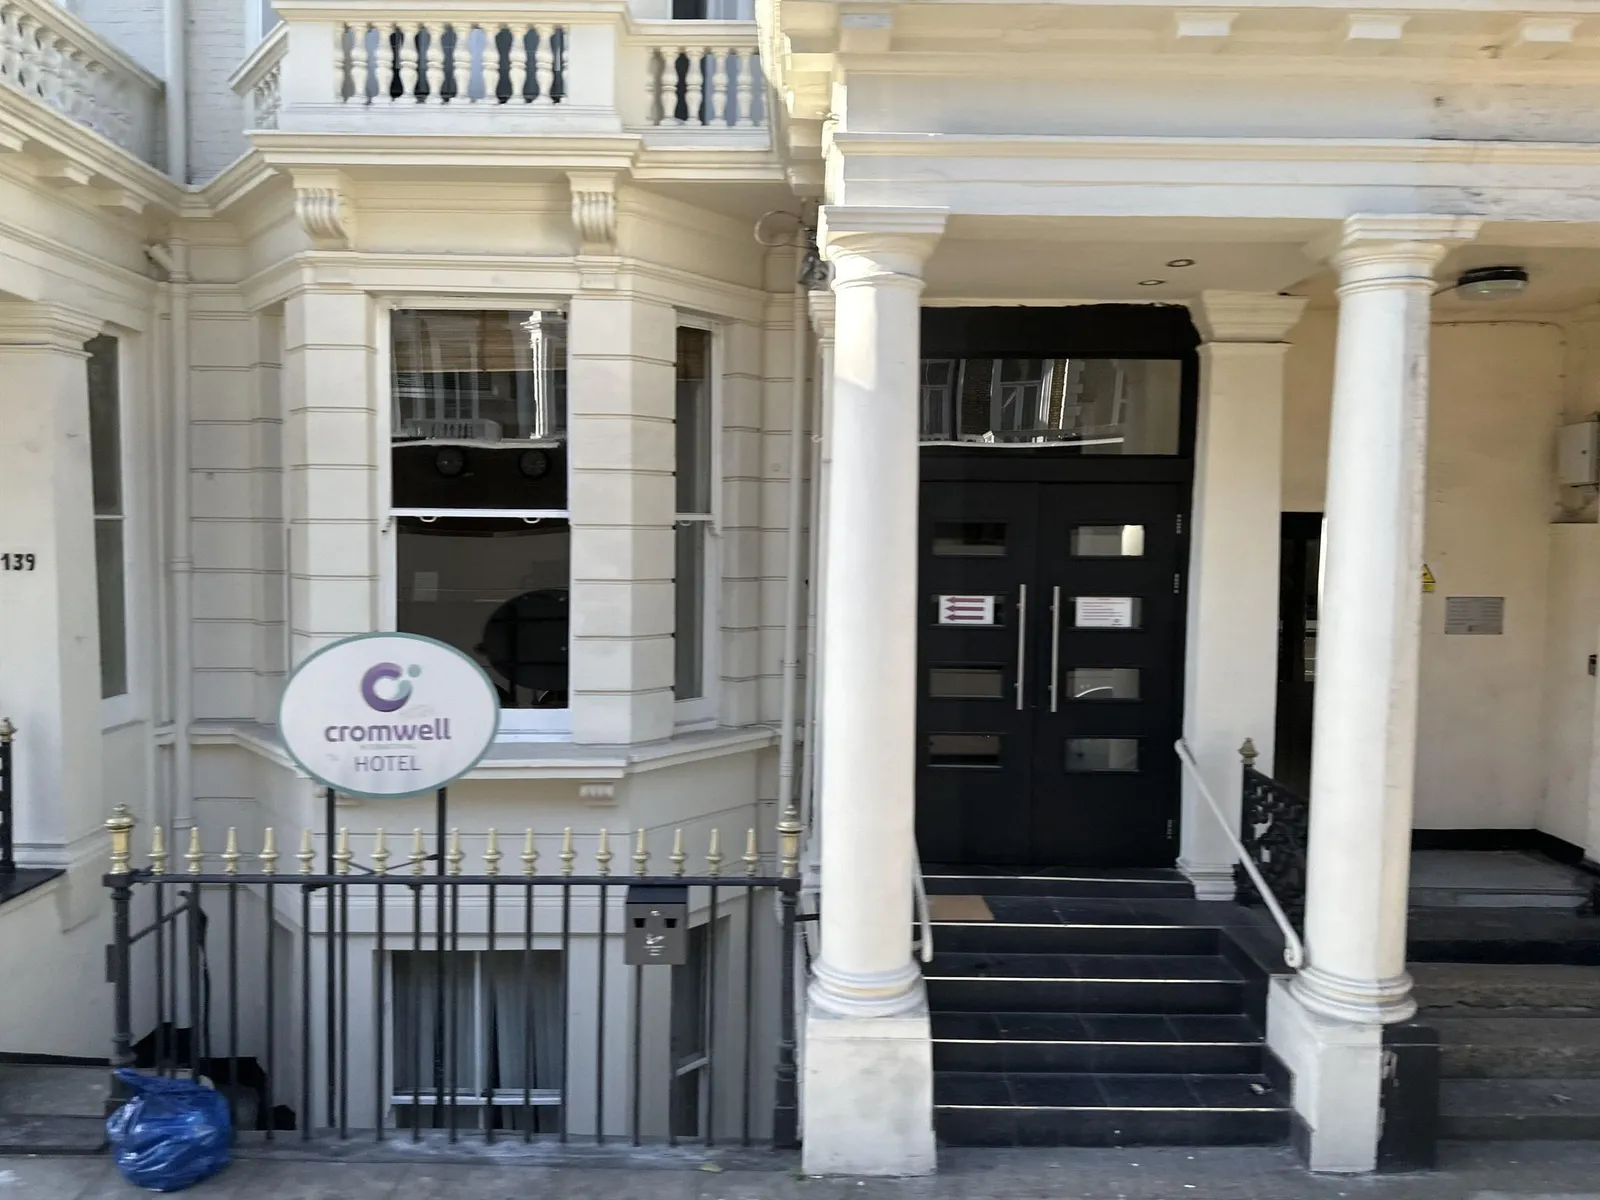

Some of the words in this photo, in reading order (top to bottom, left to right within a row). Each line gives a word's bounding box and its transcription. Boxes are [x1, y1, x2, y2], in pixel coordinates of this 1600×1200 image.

[0, 553, 35, 571] 139
[325, 717, 452, 742] cromwell
[354, 755, 422, 772] HOTEL
